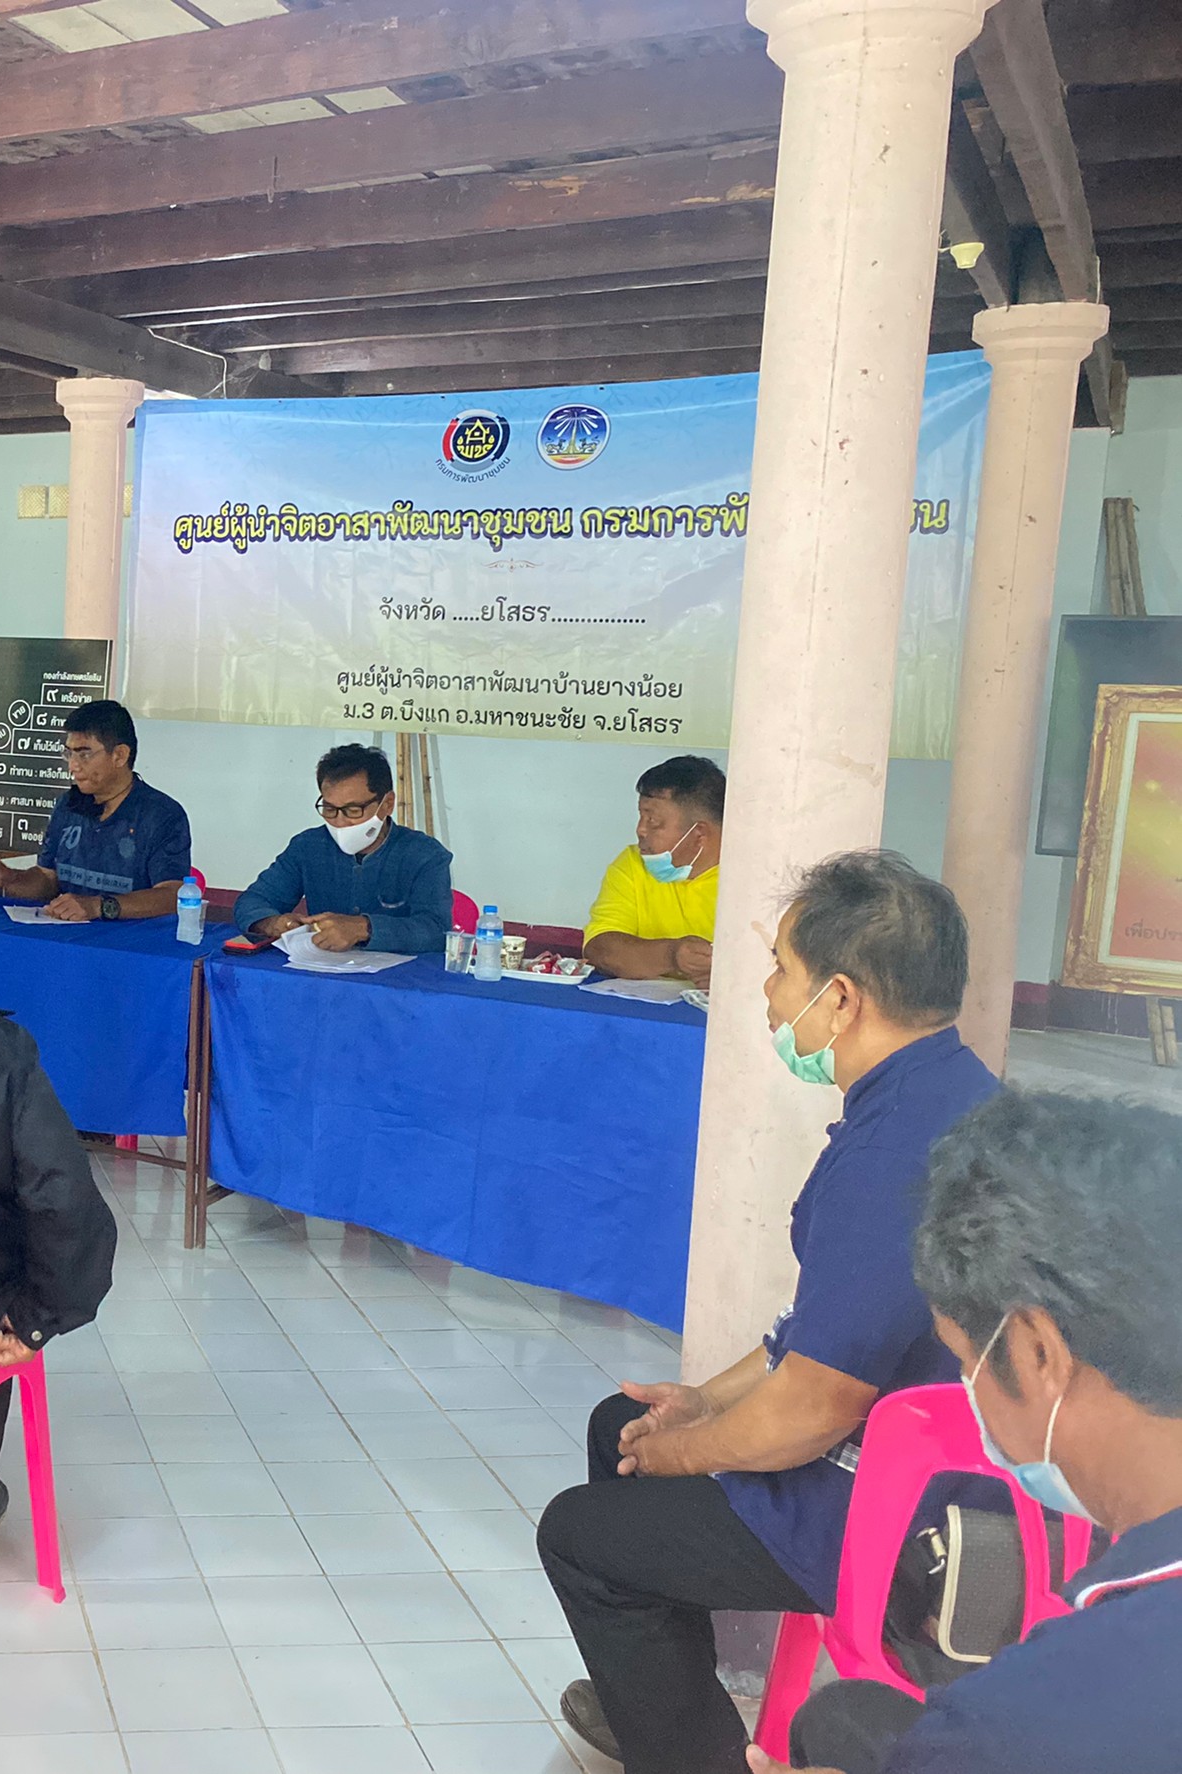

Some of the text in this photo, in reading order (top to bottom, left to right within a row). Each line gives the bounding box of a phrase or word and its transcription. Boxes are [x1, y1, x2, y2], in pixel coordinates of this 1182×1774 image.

[435, 457, 511, 483] กรมการพัฒนาชุมชน
[174, 500, 572, 552] ศูนย์ผู้นำจิตอาสาพัฒนาชุมชน
[379, 597, 446, 621] จังหวัด
[337, 664, 683, 699] ศูนย์ผู้นำจิตอาสาพัฒนาบ้านยางน้อย
[46, 689, 92, 703] ๙ เครือข่าย
[36, 712, 48, 726] ๘
[343, 699, 683, 734] ม.3 ต.บึงแก อ.มหาชนะชัย จ.ยโสธร
[18, 818, 28, 831] ๓
